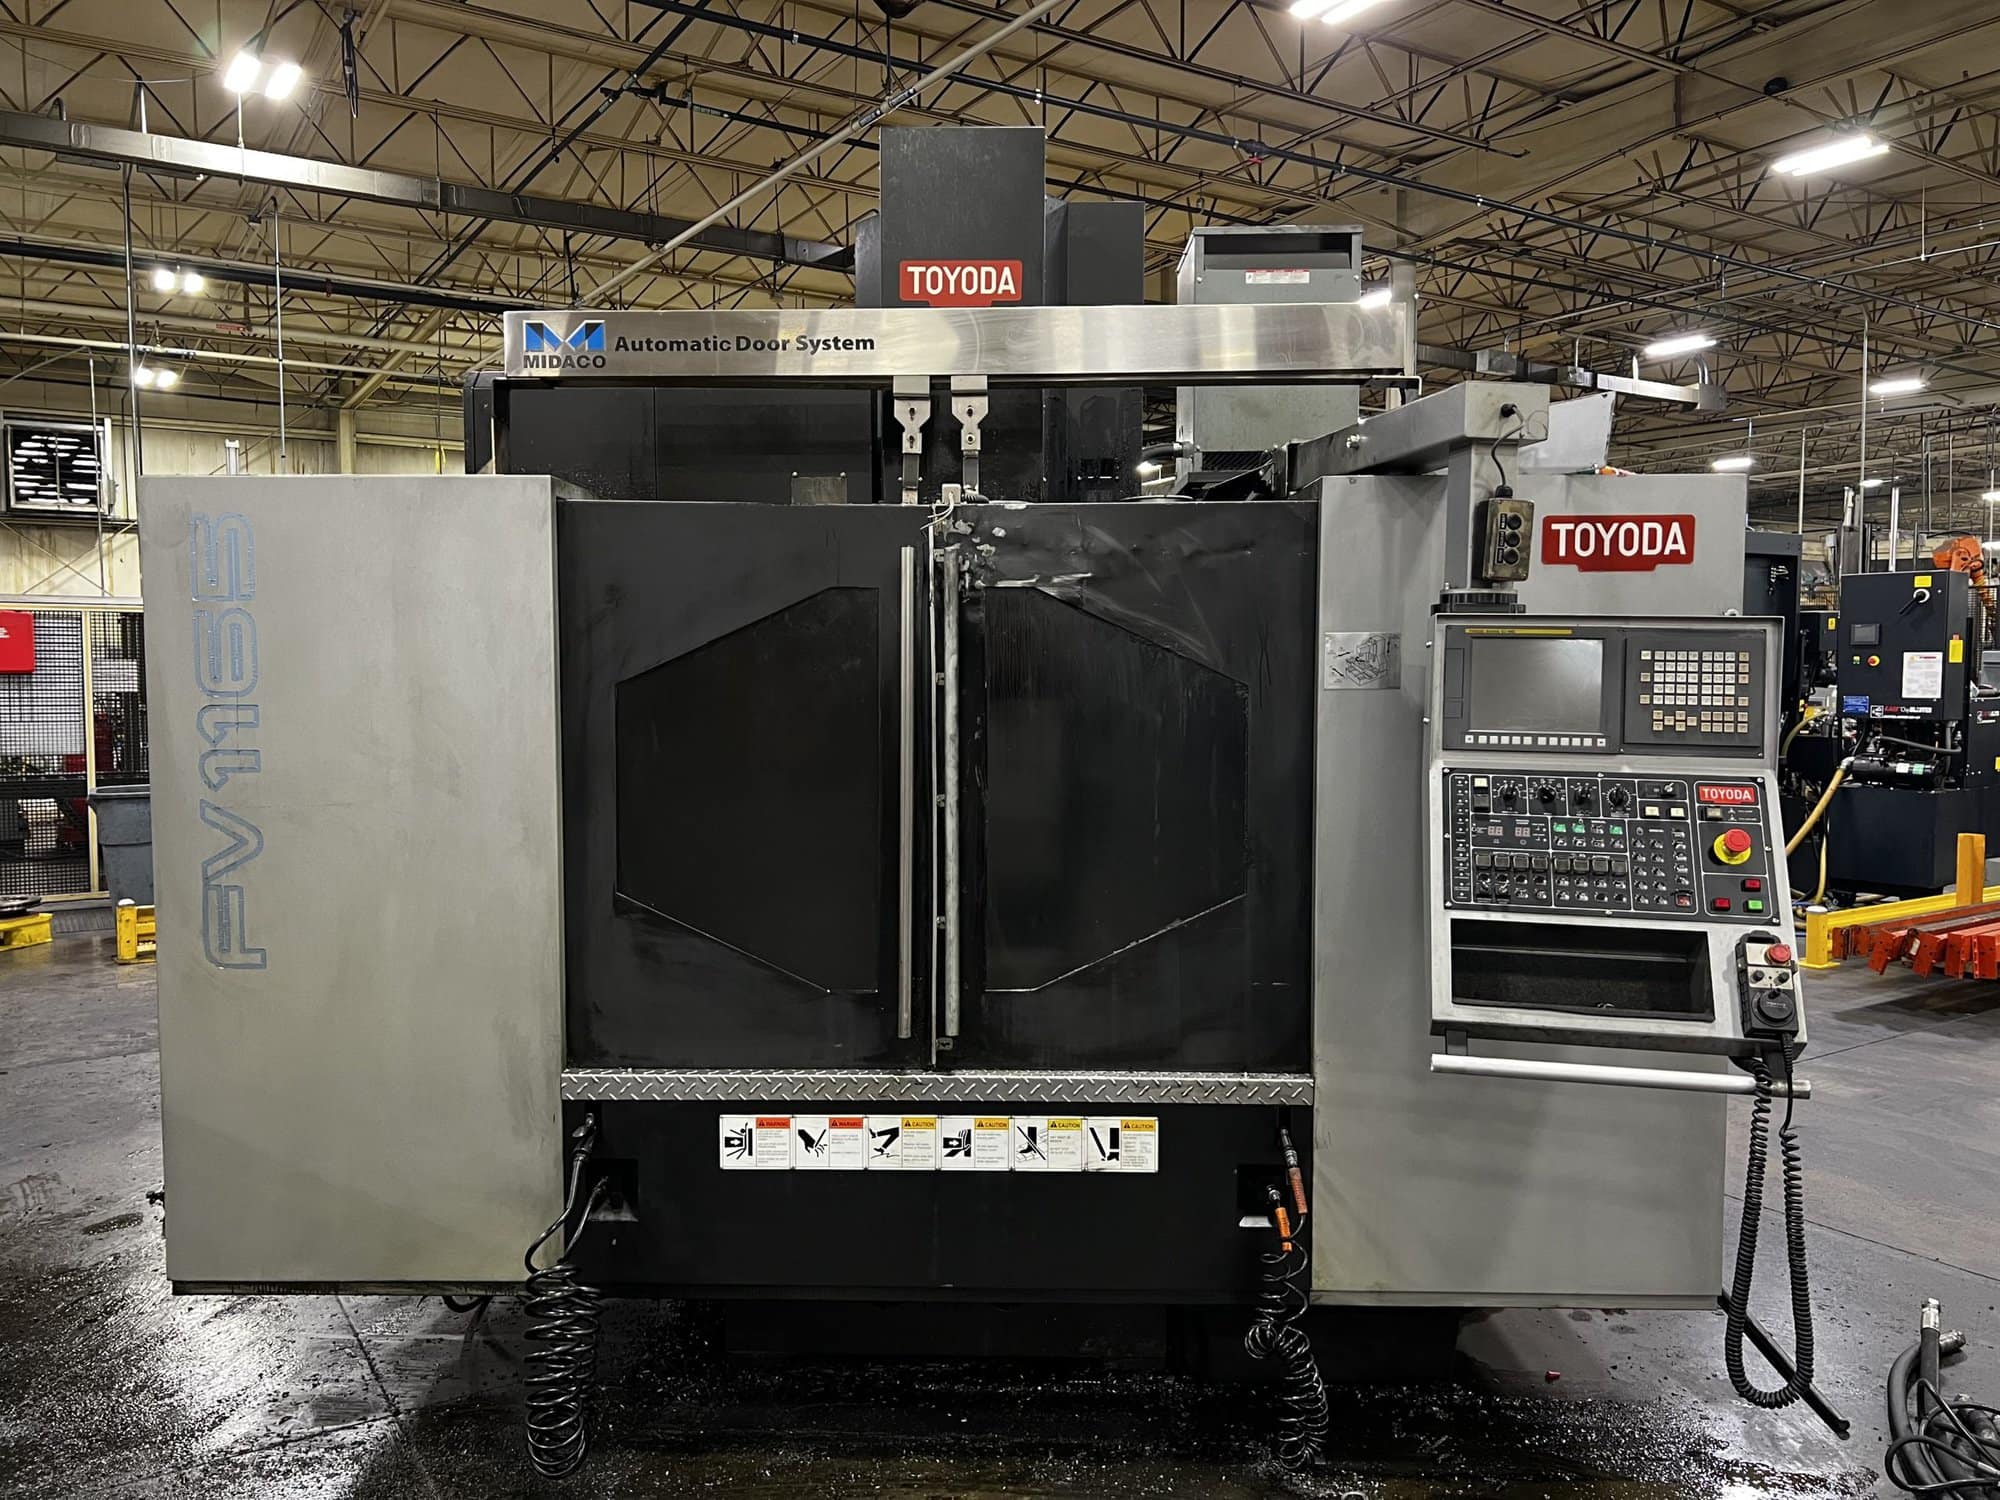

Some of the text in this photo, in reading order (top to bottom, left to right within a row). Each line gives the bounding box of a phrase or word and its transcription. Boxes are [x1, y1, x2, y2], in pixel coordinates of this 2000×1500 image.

[907, 266, 1016, 296] TOYODA
[614, 333, 876, 355] Automatic Door System
[522, 354, 607, 369] MIDACO
[1551, 521, 1687, 558] TOYODA
[1702, 787, 1752, 801] TOYODA
